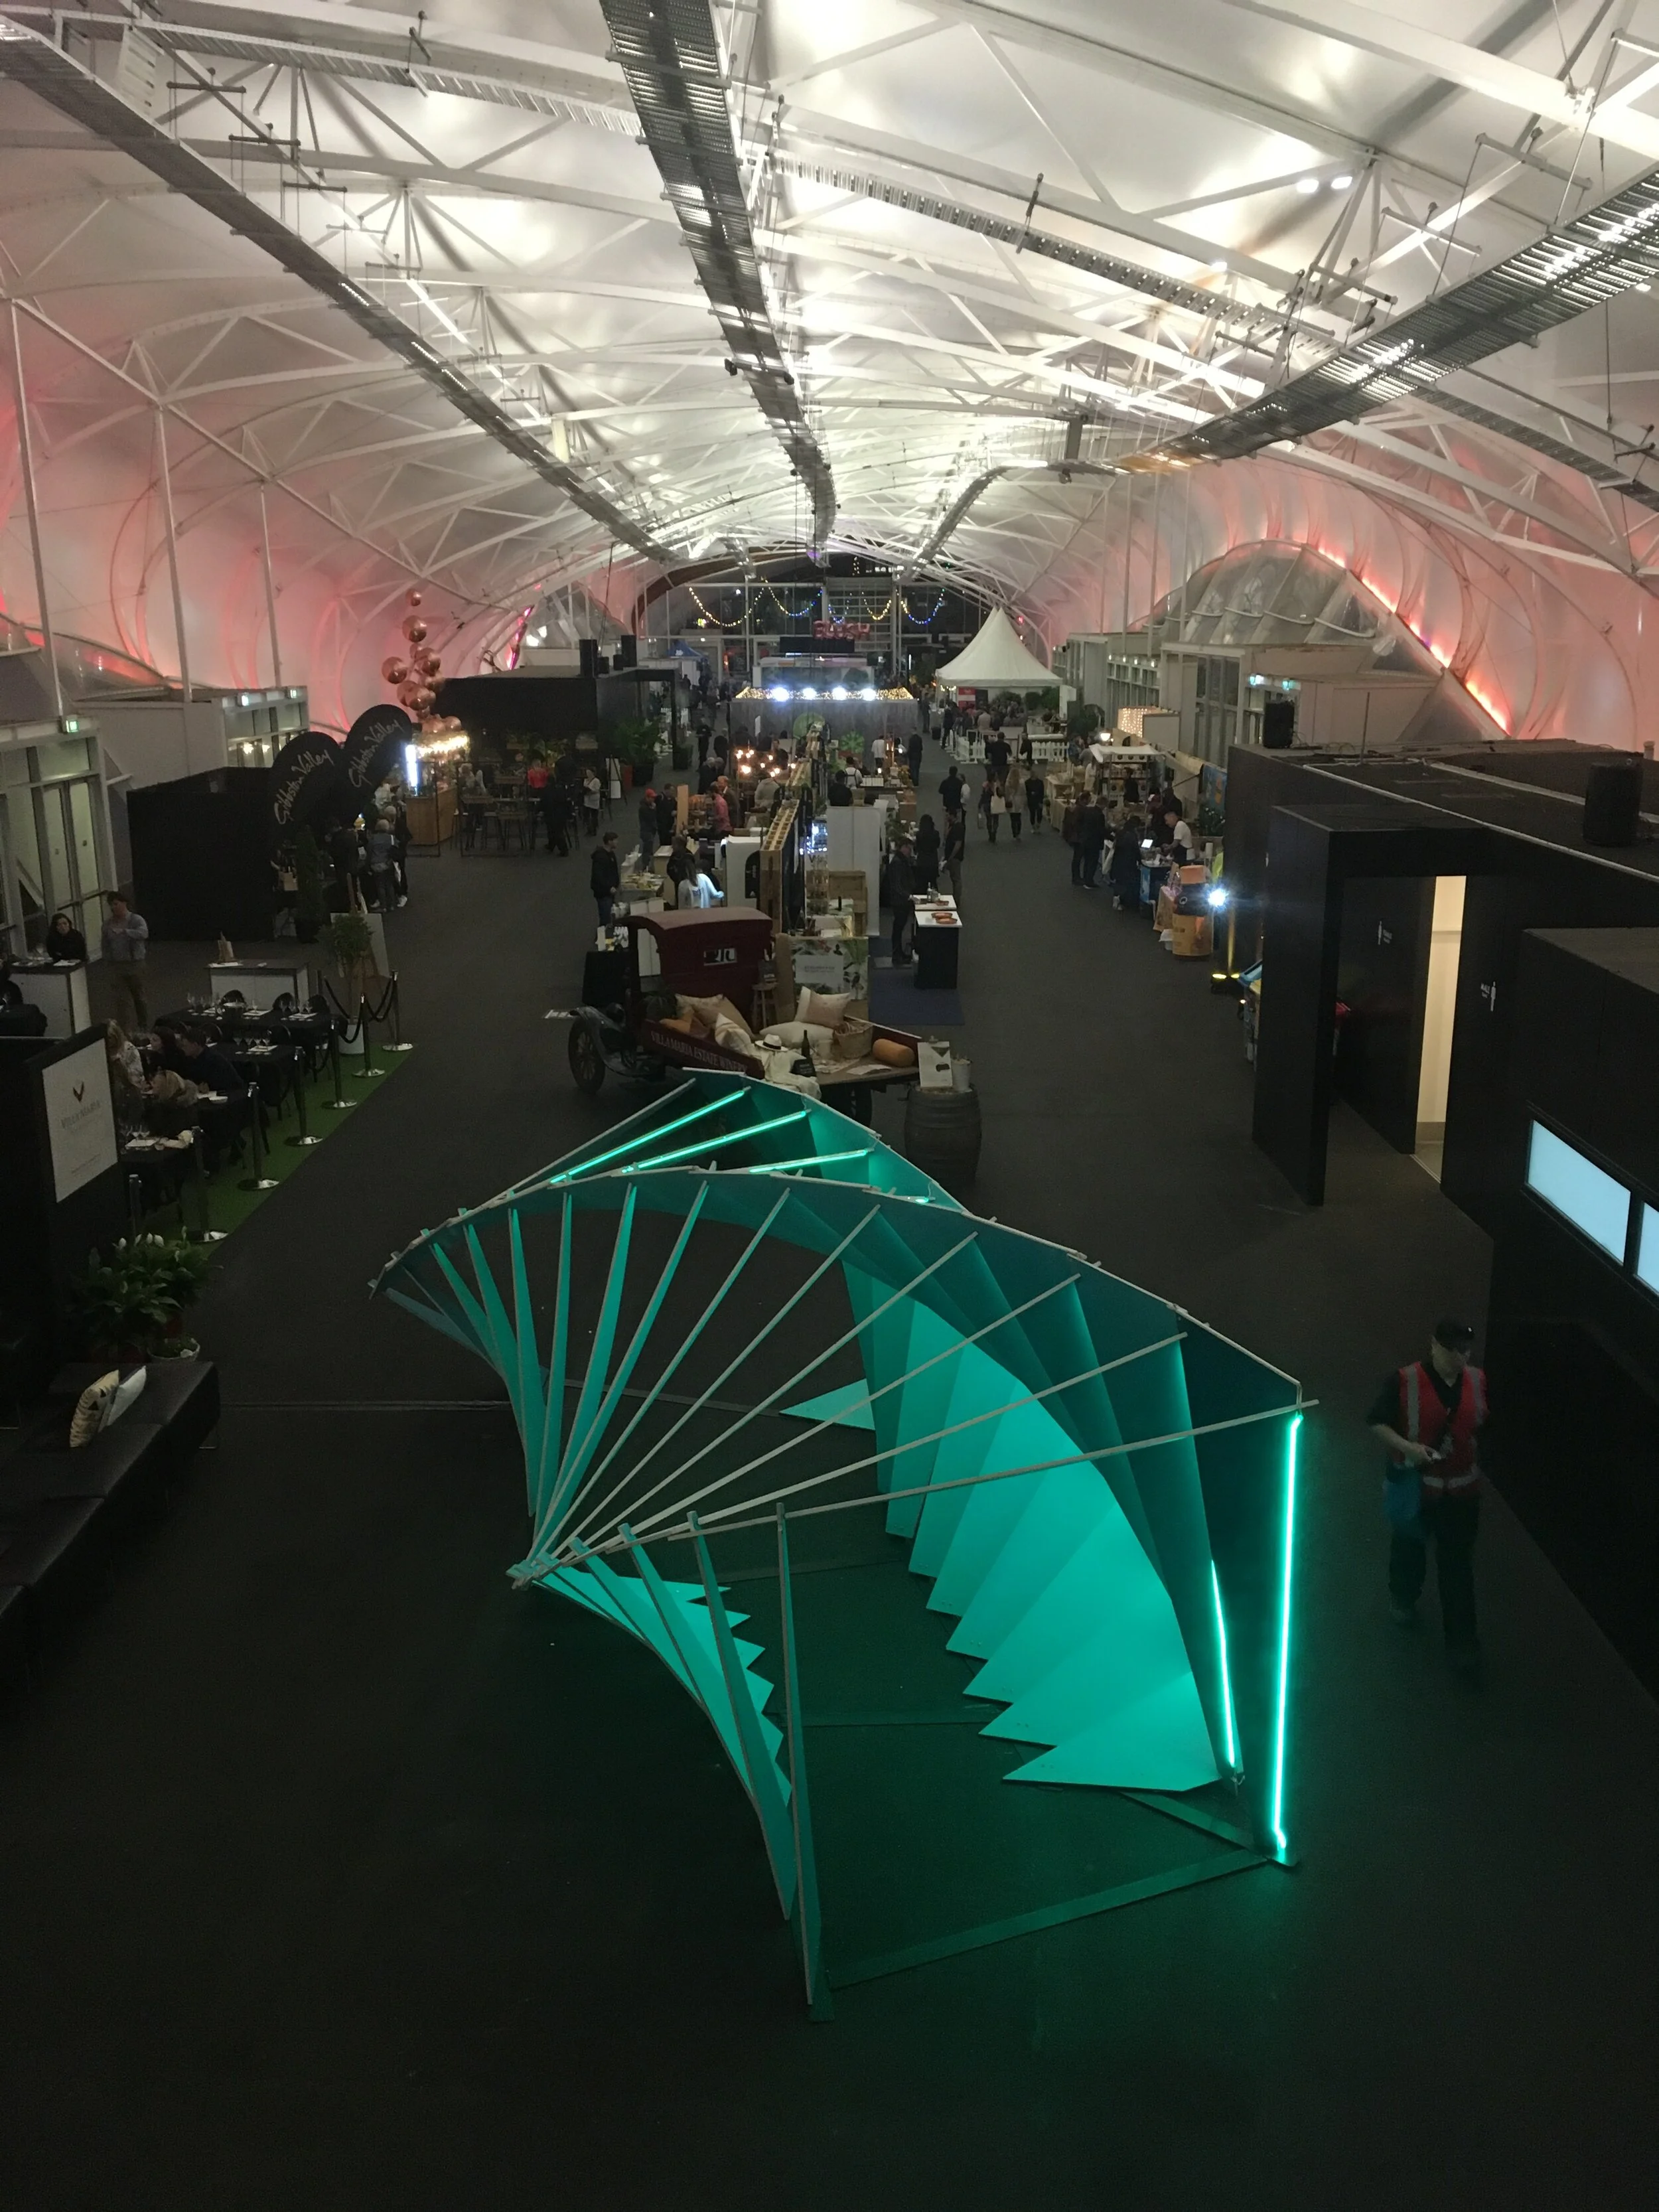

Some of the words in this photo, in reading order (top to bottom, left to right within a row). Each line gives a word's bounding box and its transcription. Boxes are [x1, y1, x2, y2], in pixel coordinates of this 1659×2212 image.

[274, 776, 305, 824] Gibbston
[291, 749, 334, 774] Valley
[348, 745, 378, 788] Gibbston
[364, 719, 405, 743] Valley
[693, 1047, 717, 1066] ESTATE
